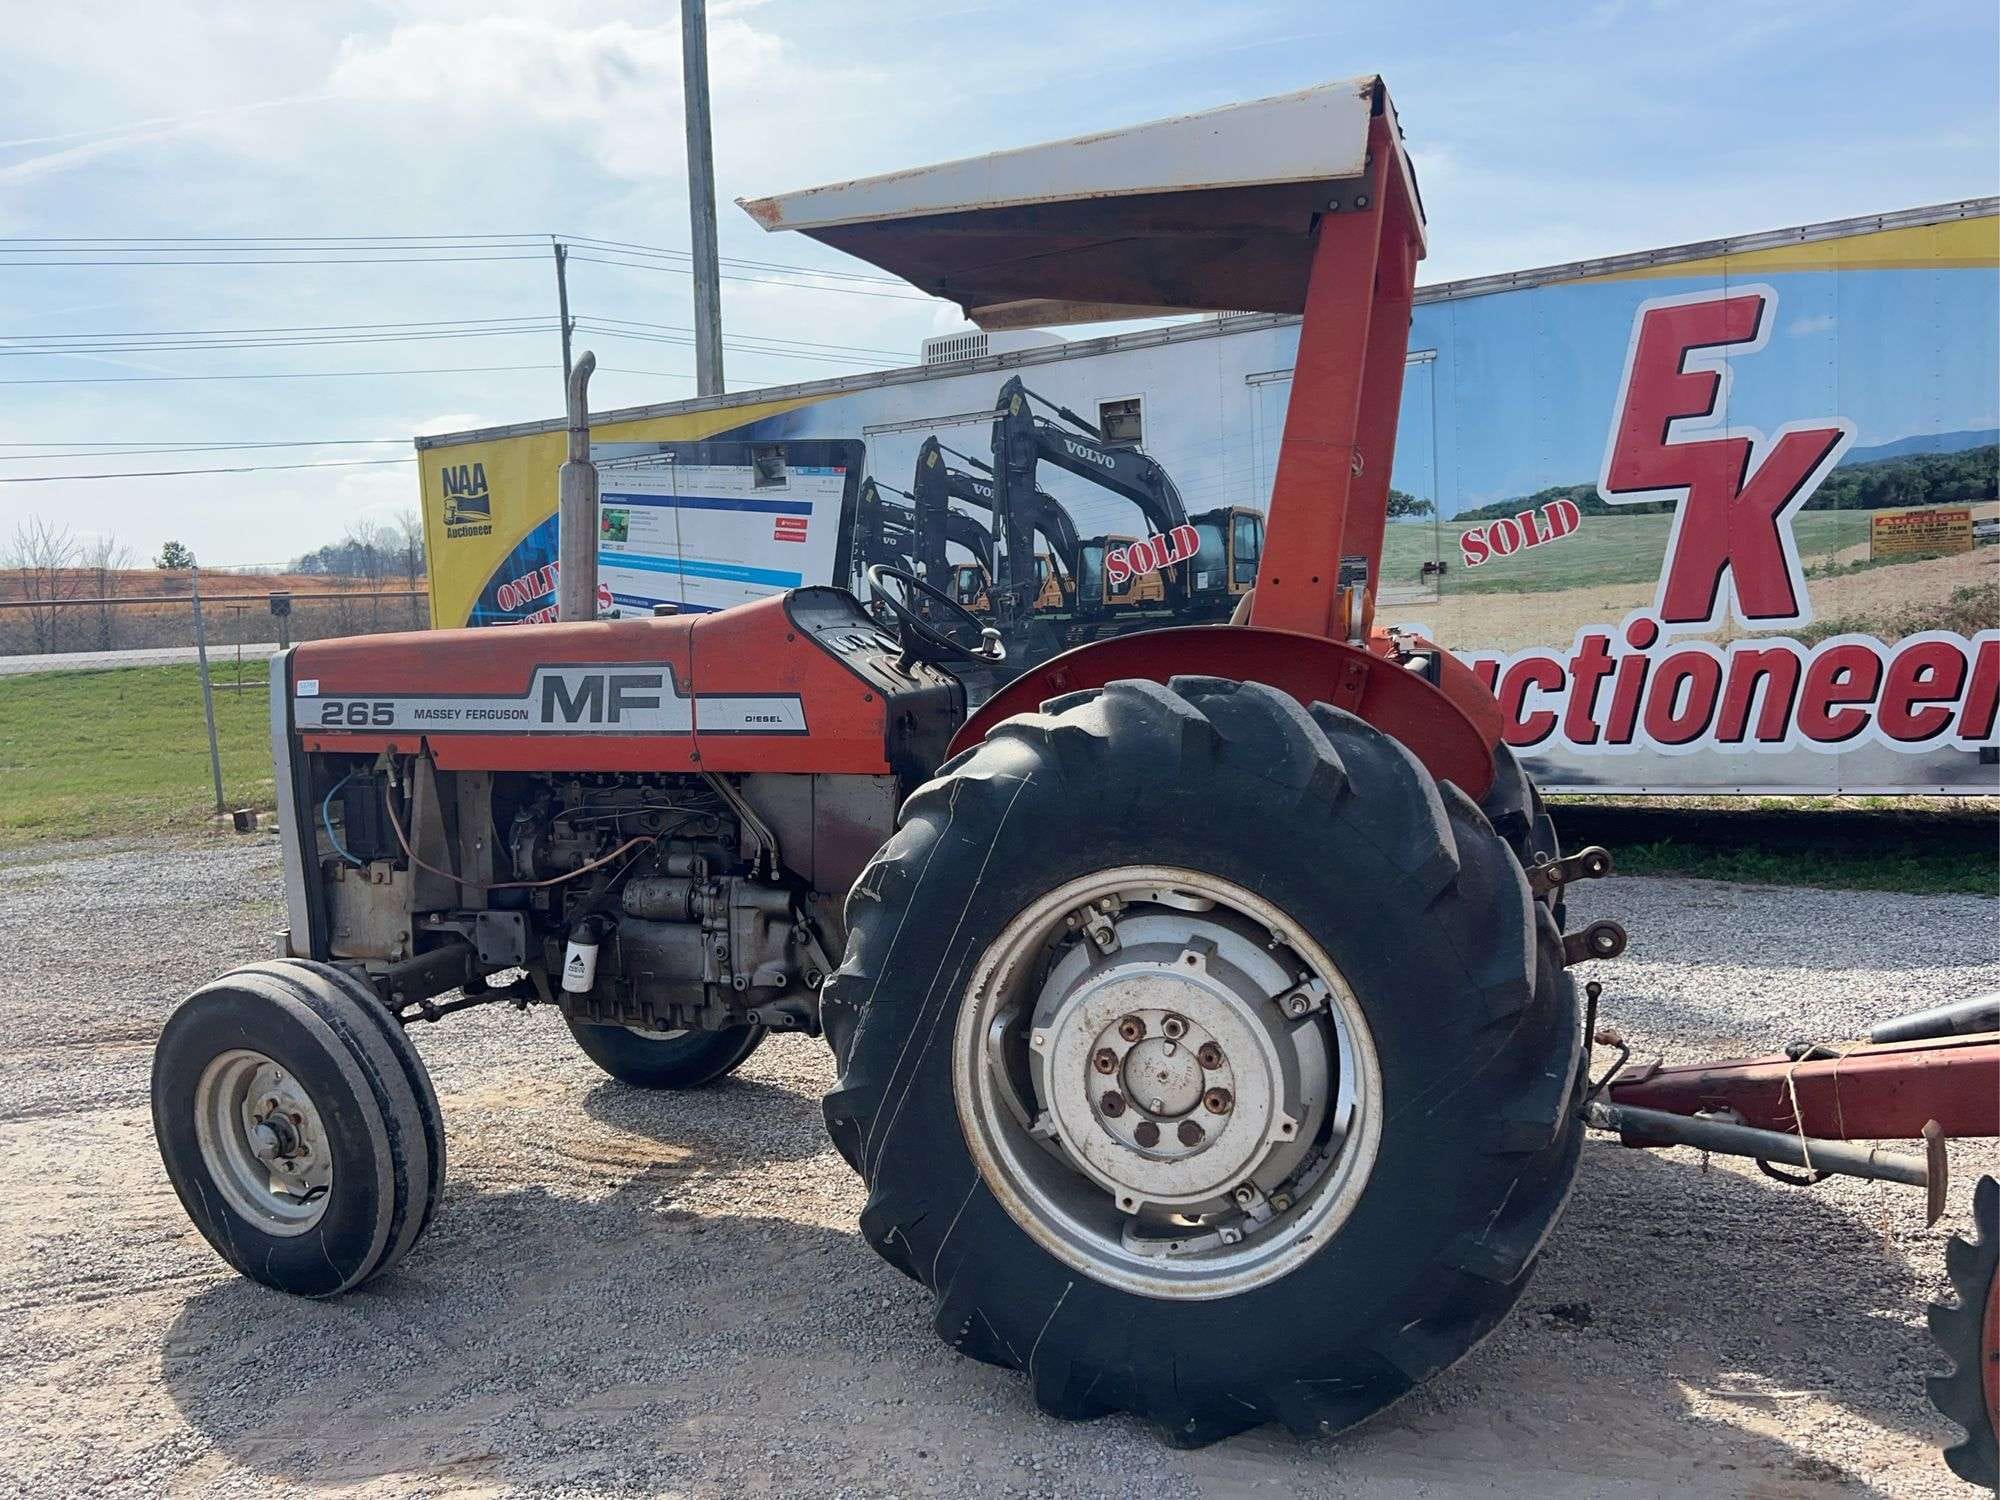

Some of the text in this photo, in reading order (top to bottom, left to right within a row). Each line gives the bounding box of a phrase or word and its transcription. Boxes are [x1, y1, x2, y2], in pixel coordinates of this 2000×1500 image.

[1063, 438, 1117, 470] VOLVO
[442, 462, 489, 499] NAA
[448, 525, 493, 538] Auctioneer
[1460, 499, 1581, 568] SOLD
[1105, 523, 1200, 584] SOLD
[321, 702, 529, 726] 265 MASSEY FERGUSON
[541, 674, 663, 723] MF
[745, 715, 783, 723] DIESEL
